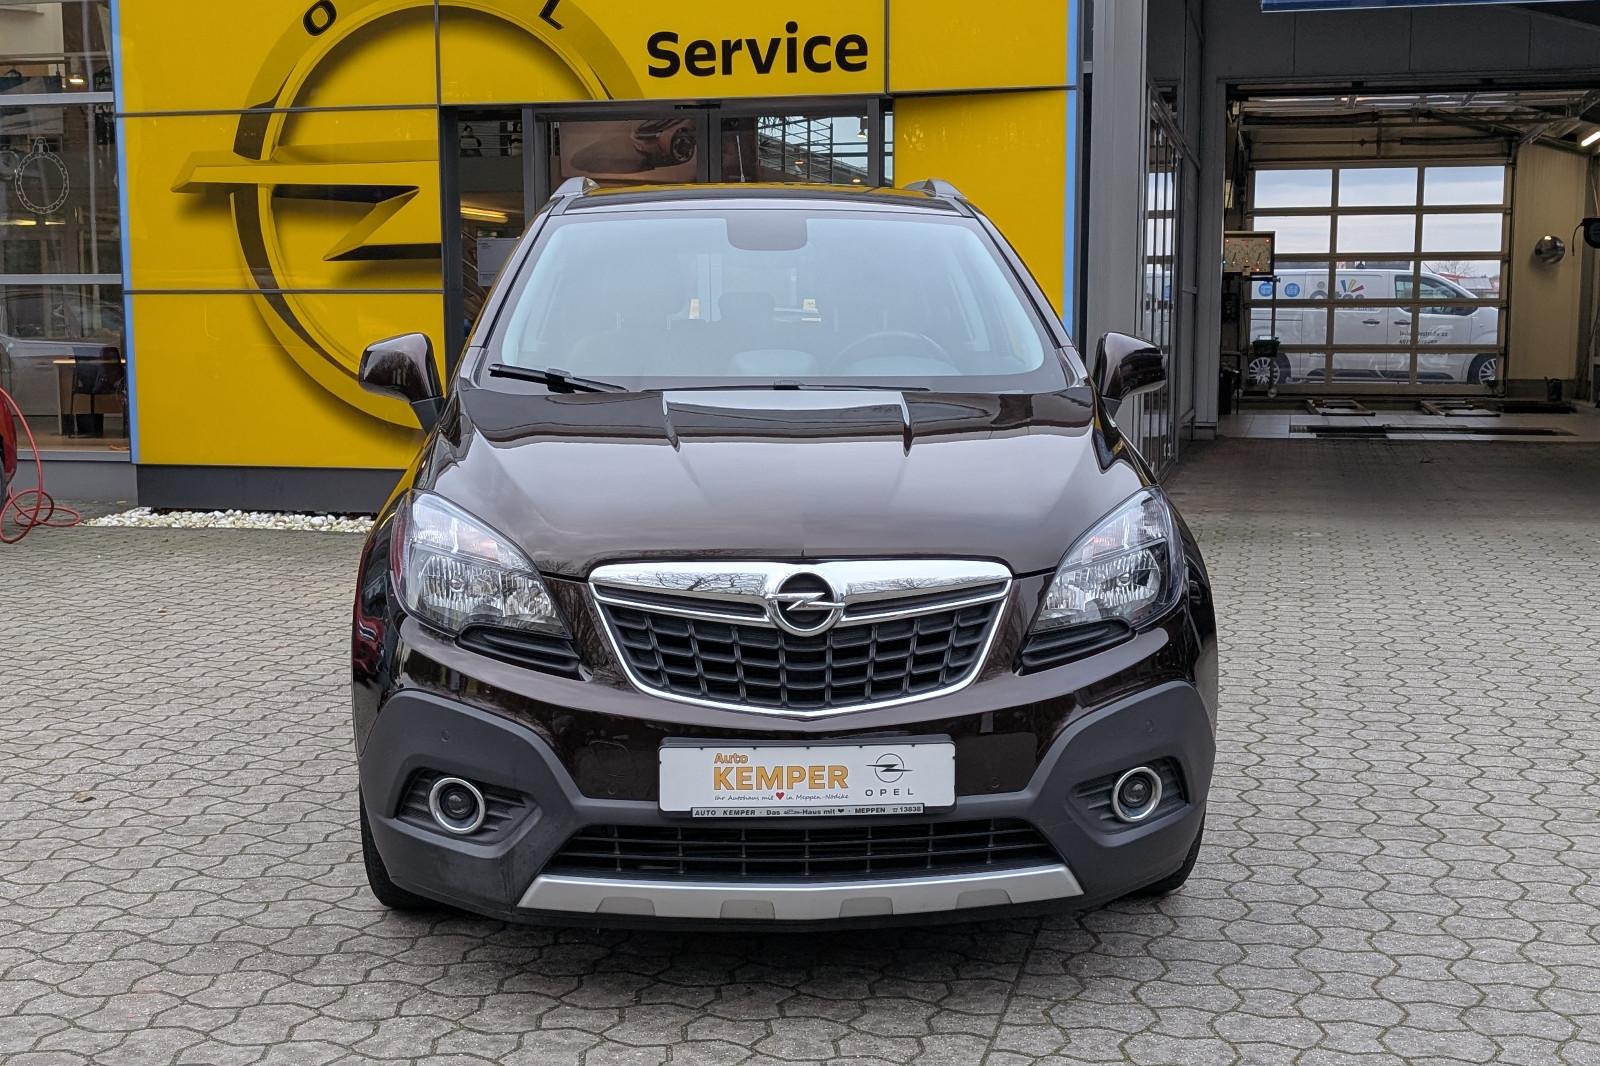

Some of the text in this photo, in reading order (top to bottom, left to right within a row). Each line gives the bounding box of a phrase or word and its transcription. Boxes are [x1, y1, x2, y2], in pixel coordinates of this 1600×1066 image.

[647, 21, 868, 78] Service
[714, 753, 749, 764] Auto
[713, 765, 849, 790] KEMPER
[865, 787, 914, 797] OPEL
